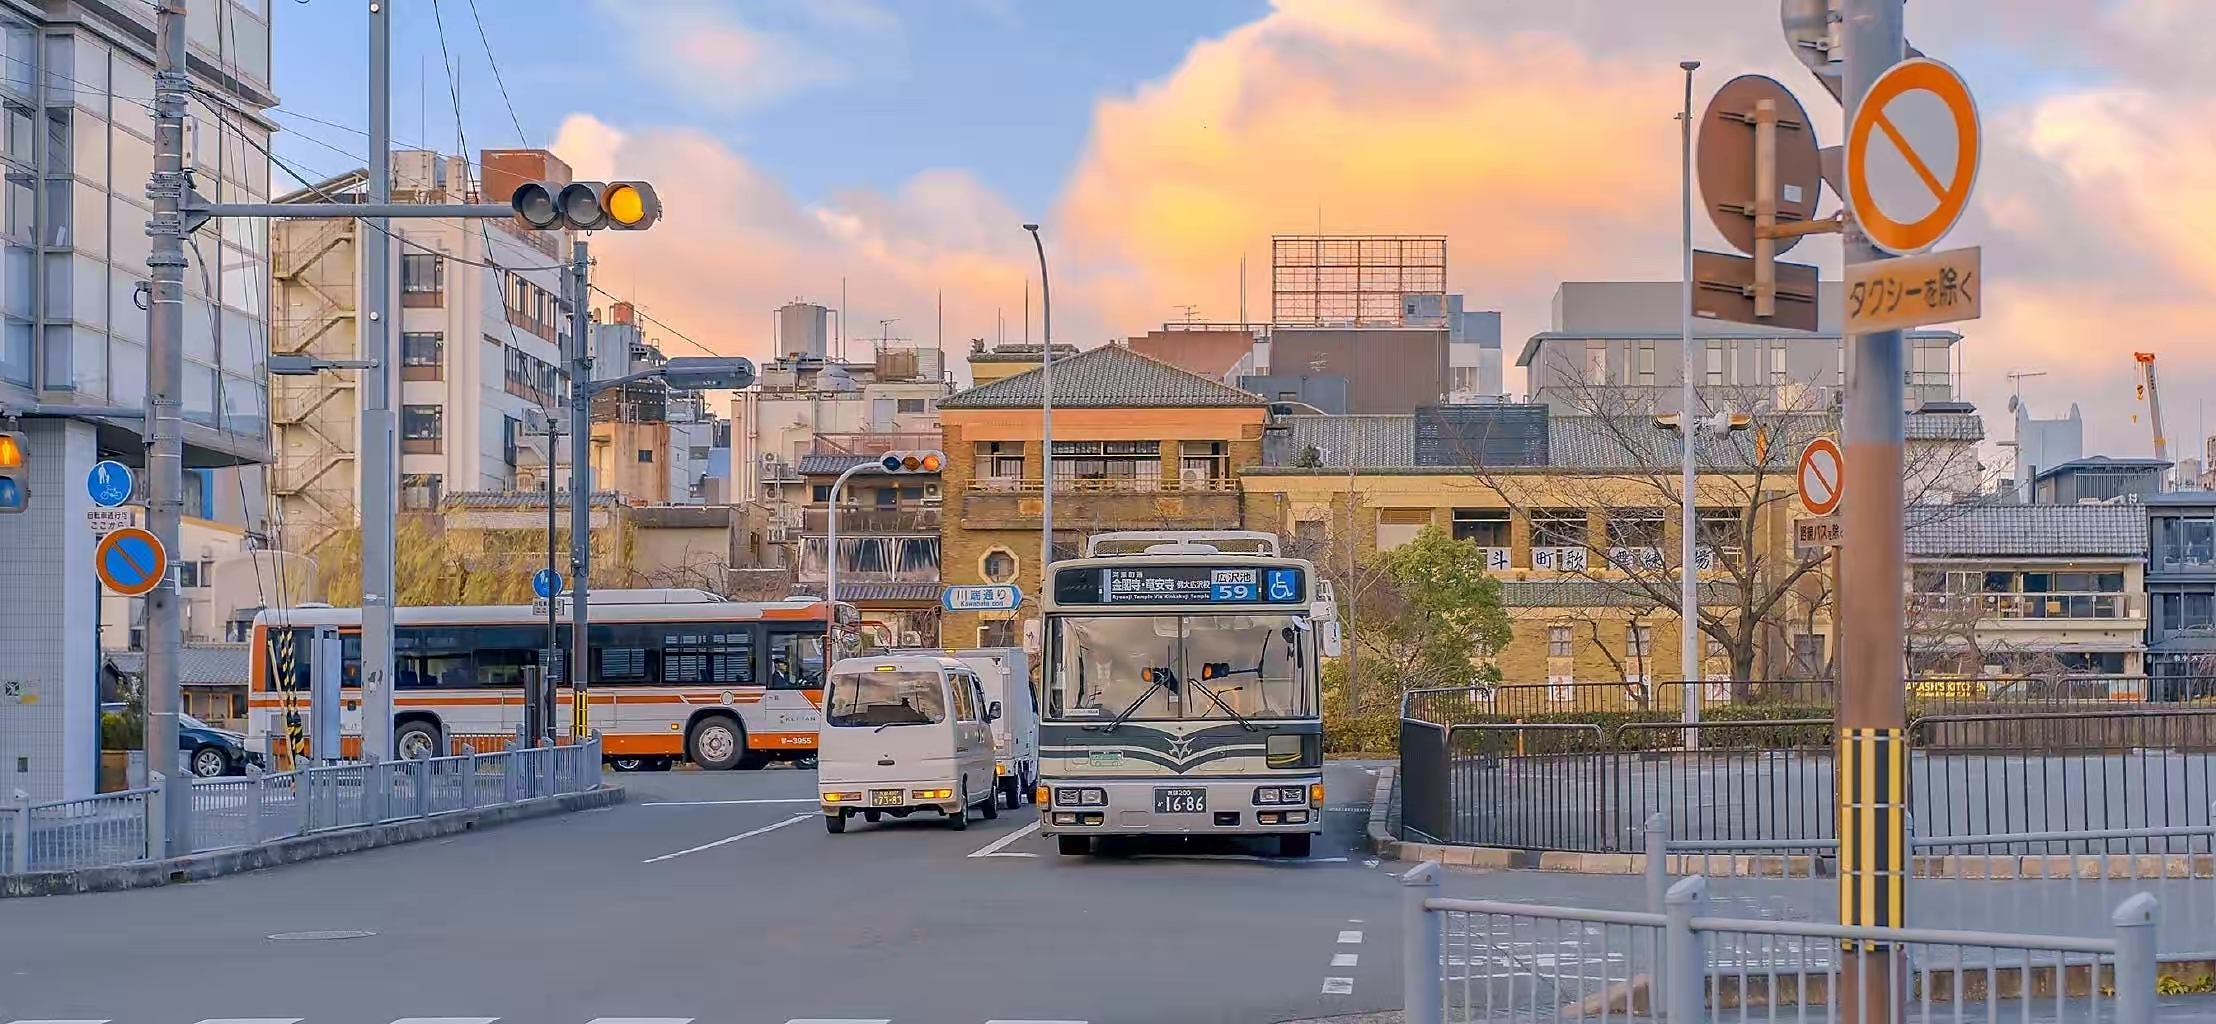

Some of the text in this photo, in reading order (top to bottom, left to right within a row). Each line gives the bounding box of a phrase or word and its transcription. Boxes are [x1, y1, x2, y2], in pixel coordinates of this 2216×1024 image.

[1849, 266, 1972, 318] タクシーを除く
[1216, 572, 1251, 583] 広沢池
[957, 589, 1007, 601] 川端通り
[1219, 585, 1249, 599] 59
[878, 796, 903, 805] 73-83
[1166, 796, 1204, 812] 16-86
